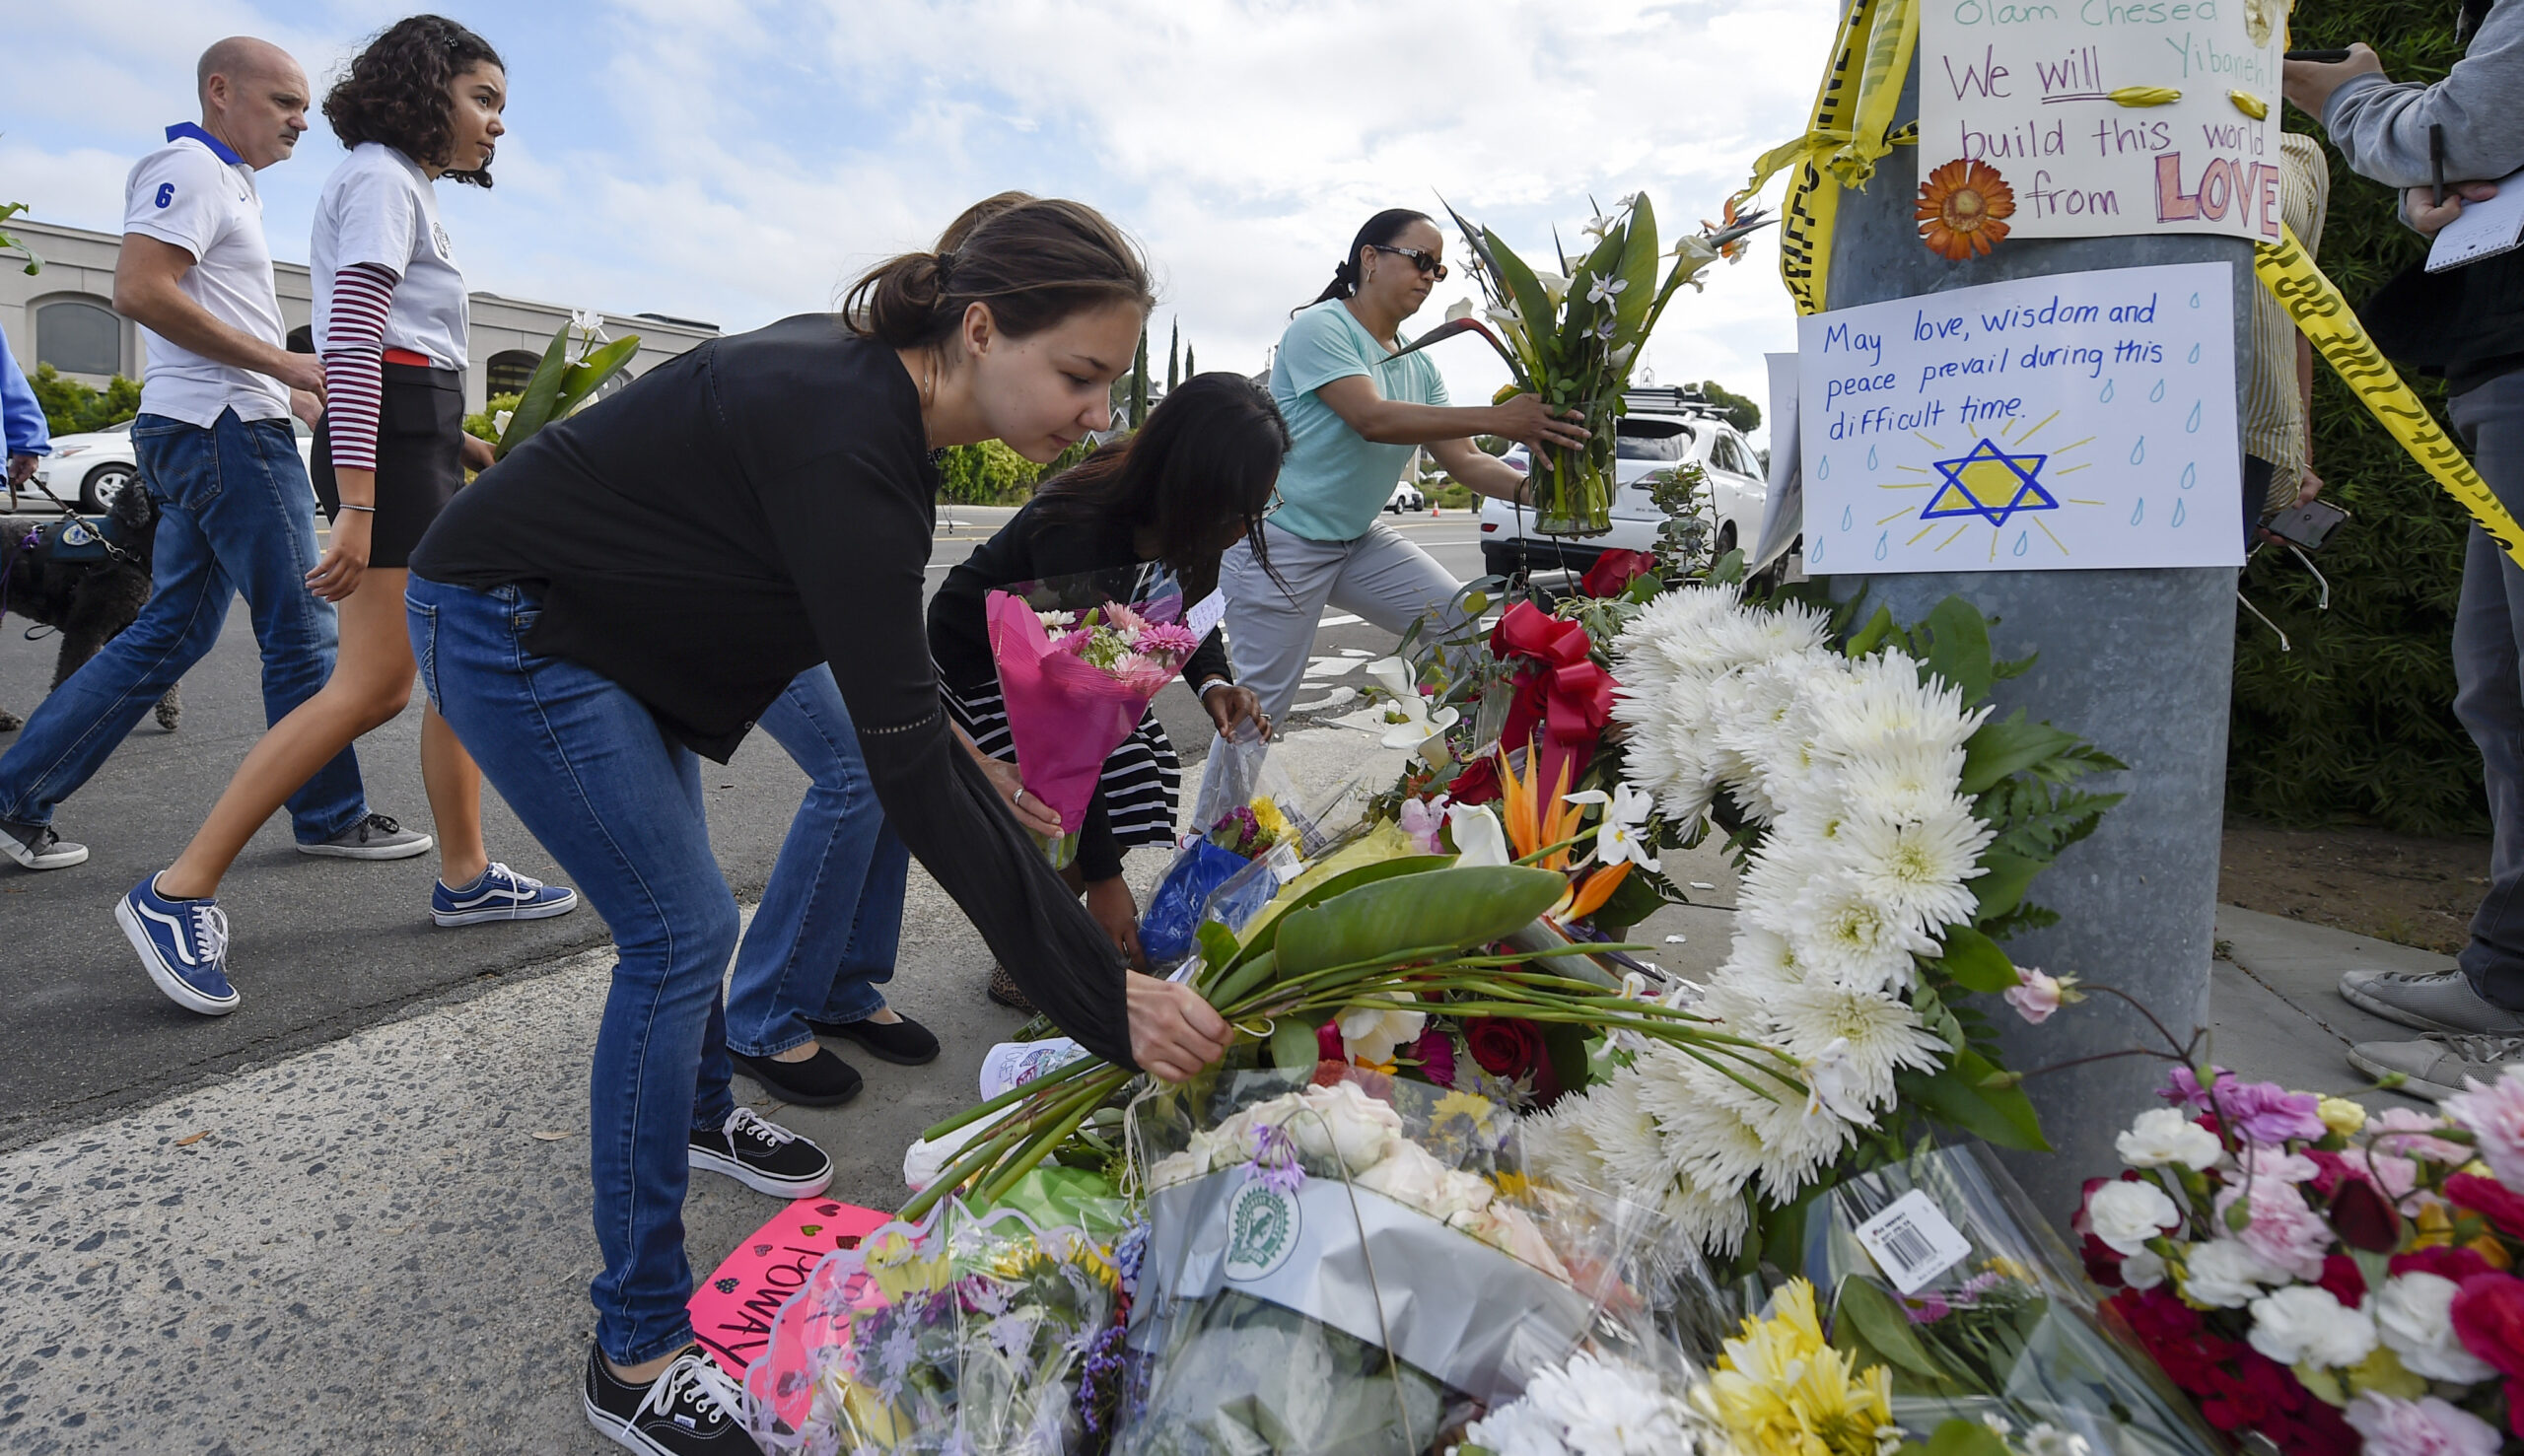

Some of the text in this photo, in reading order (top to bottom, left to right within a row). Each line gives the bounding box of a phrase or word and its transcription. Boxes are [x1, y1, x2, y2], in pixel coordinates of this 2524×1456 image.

[1954, 0, 2219, 26] Olam Chesed
[1942, 43, 2012, 102] We
[2036, 45, 2102, 94] will
[1960, 117, 2265, 163] build this world
[154, 182, 175, 209] 6
[2024, 151, 2279, 239] from LOVE
[1823, 292, 2157, 368] May love, wisdom and
[1825, 372, 1897, 413] peace
[1918, 347, 2009, 394] prevail
[2019, 343, 2104, 379] during
[2114, 339, 2164, 364] this
[1829, 398, 1945, 442] difficult
[1960, 395, 2027, 425] time.
[999, 1043, 1031, 1085] TOGET
[694, 1246, 826, 1368] POWAY
